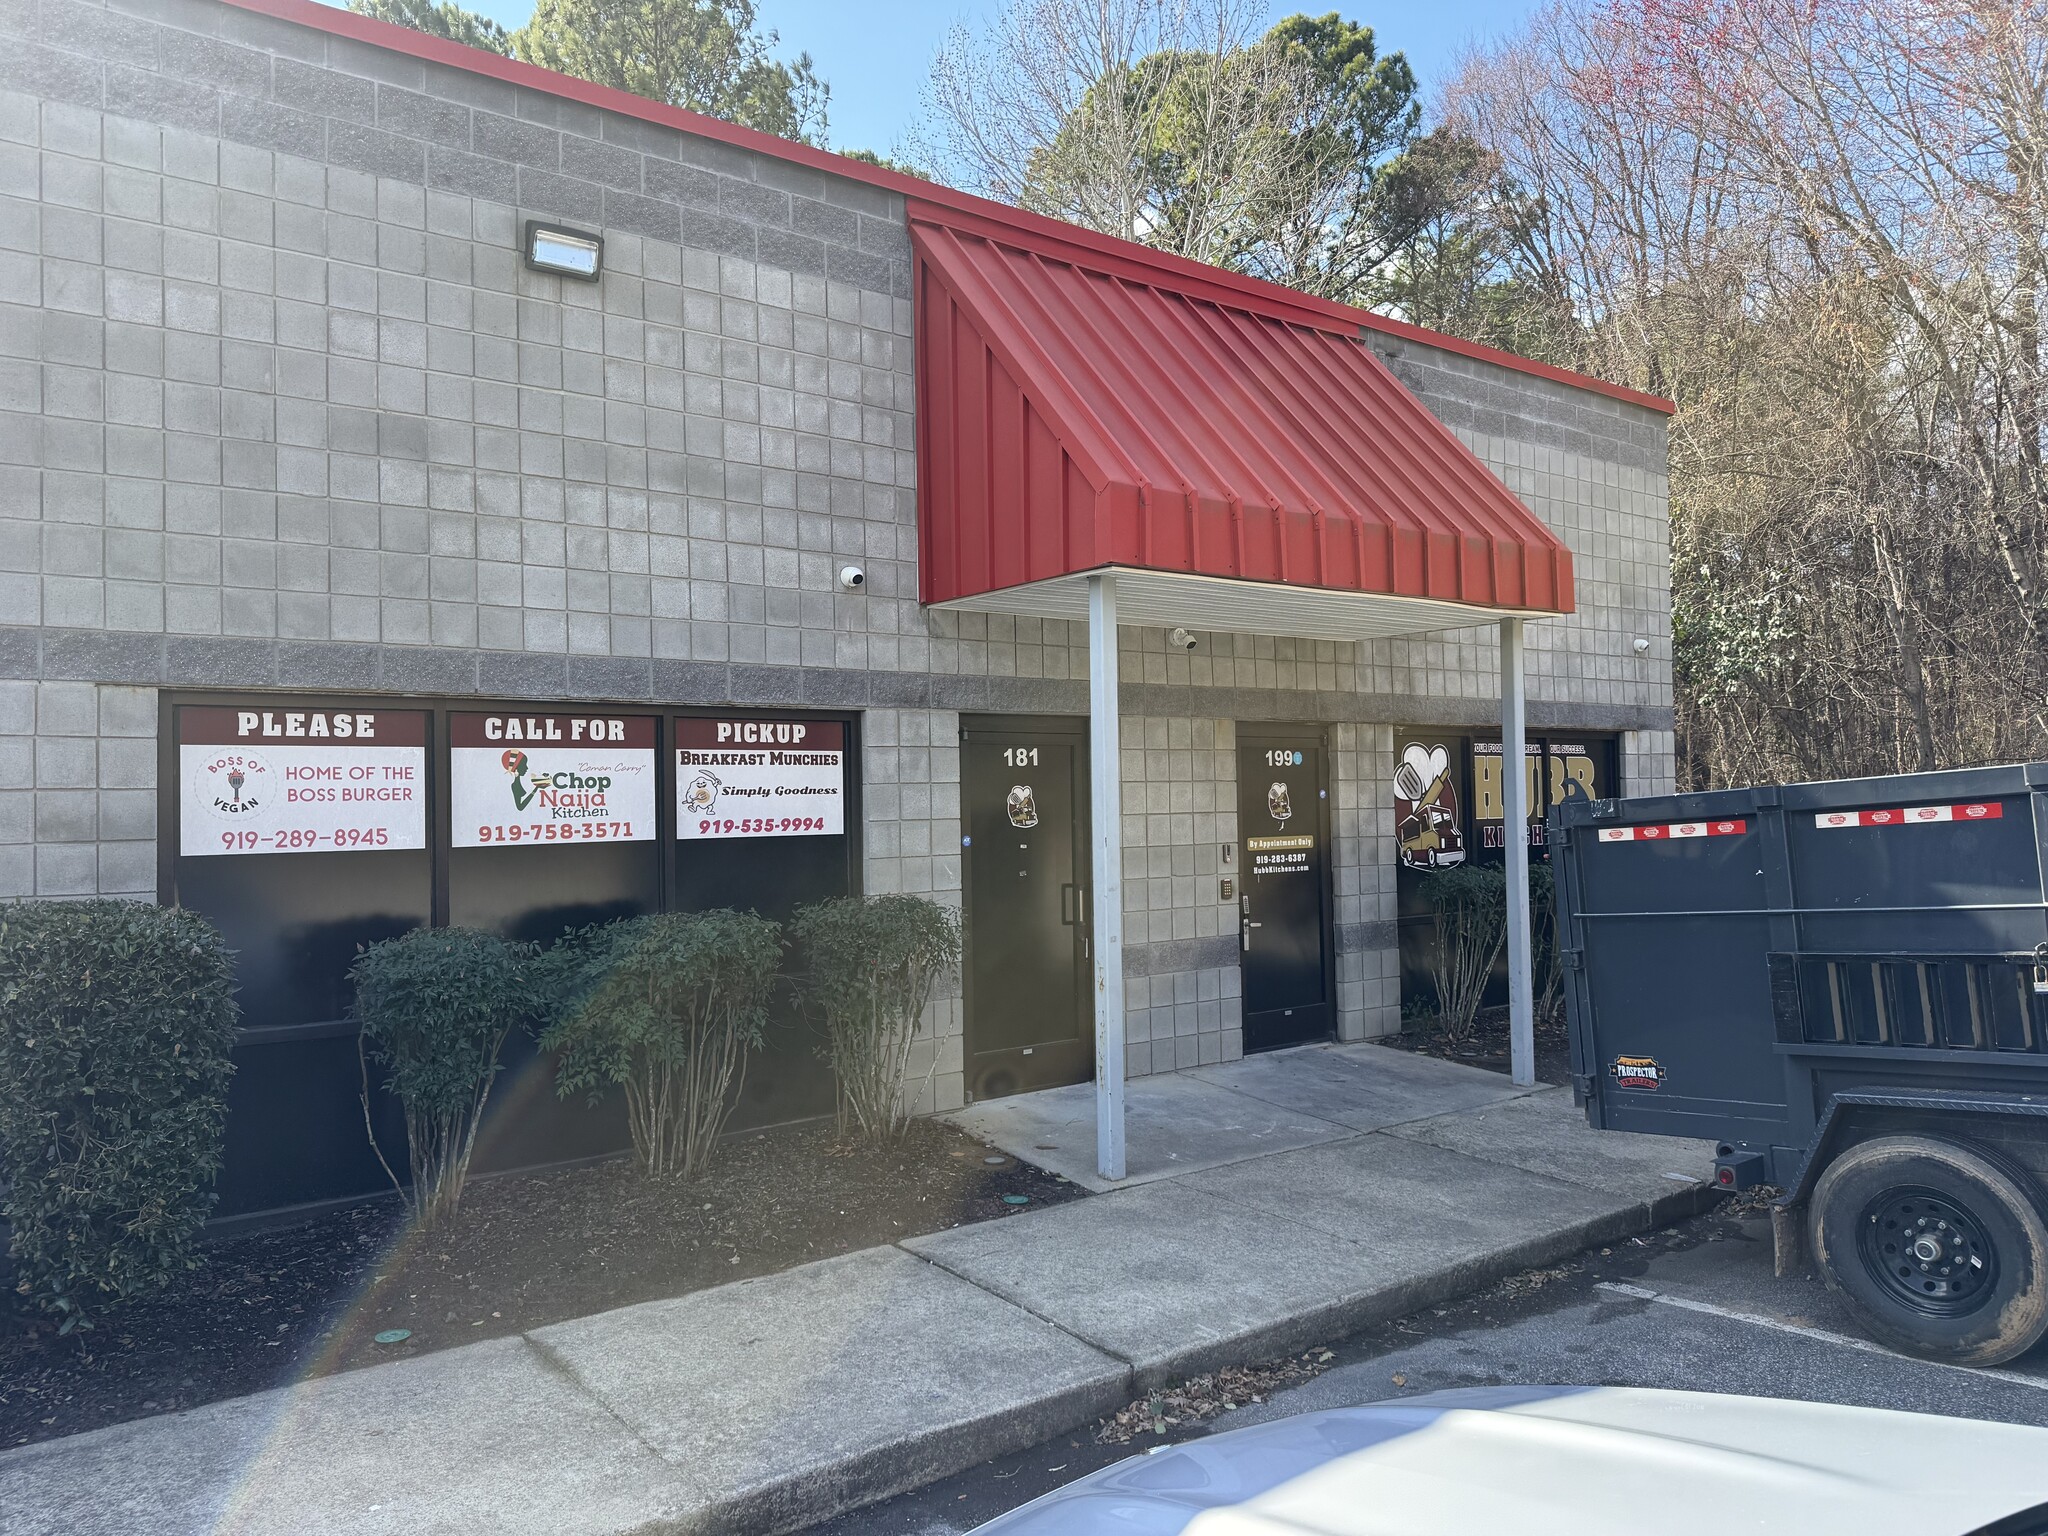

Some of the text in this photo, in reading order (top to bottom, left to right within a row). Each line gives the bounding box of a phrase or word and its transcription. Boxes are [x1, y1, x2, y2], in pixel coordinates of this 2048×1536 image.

[238, 712, 375, 737] PLEASE
[485, 717, 625, 741] CALL FOR
[717, 722, 806, 744] PICKUP
[207, 756, 266, 773] BOSS OF
[680, 751, 839, 766] BREAKFAST MUNCHIES
[1003, 748, 1039, 767] 181
[1265, 750, 1293, 767] 199
[286, 766, 414, 780] HOME OF THE
[552, 772, 611, 792] Chop
[287, 788, 413, 802] BOSS BURGER
[539, 789, 606, 809] Naija
[721, 786, 838, 798] Simply Goodness
[214, 797, 259, 812] VEGAN
[552, 807, 609, 819] Kitchen
[479, 821, 633, 842] 919-758-3571
[699, 817, 824, 834] 919-535-9994
[221, 828, 388, 850] 919-289-8945
[1249, 838, 1312, 848] By Appointment Only
[1617, 1065, 1658, 1078] PROSPECTOR
